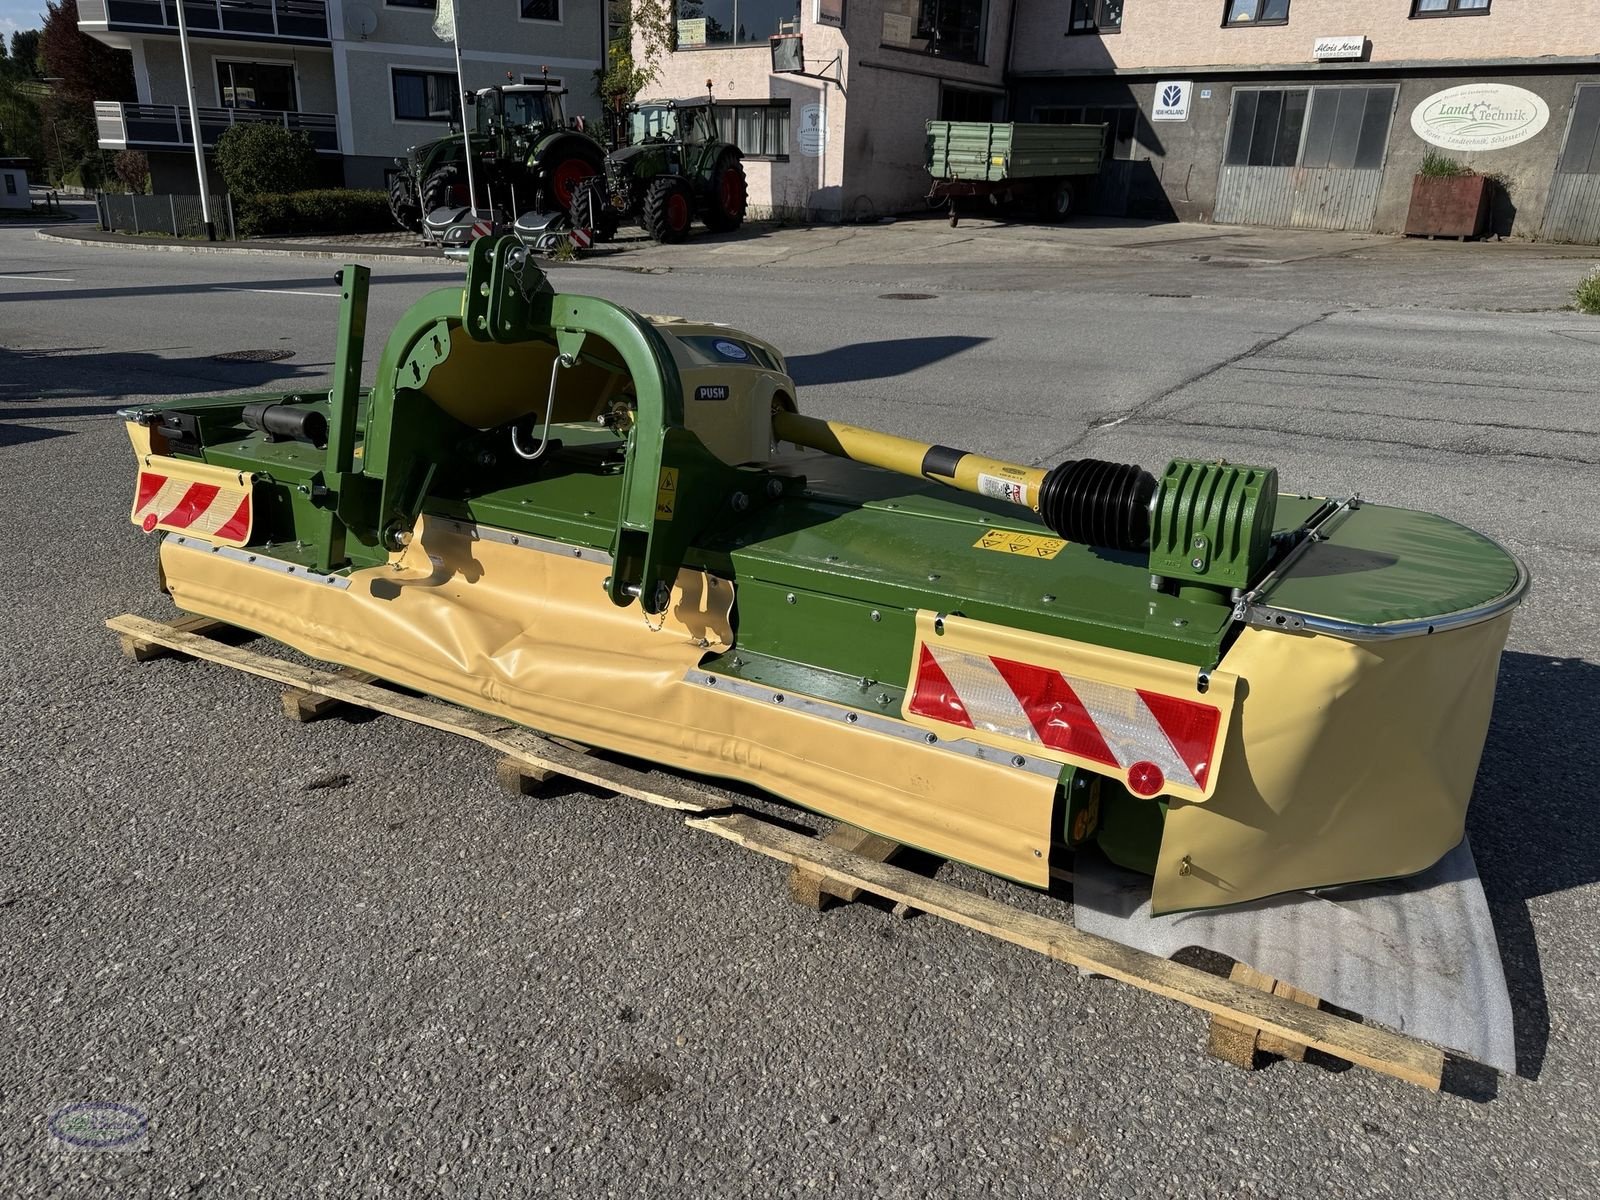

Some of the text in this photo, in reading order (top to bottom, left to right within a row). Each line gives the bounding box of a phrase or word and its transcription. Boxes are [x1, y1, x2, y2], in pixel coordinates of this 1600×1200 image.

[1315, 42, 1361, 52] Alois Moser
[1440, 103, 1470, 115] Land
[700, 387, 725, 399] PUSH
